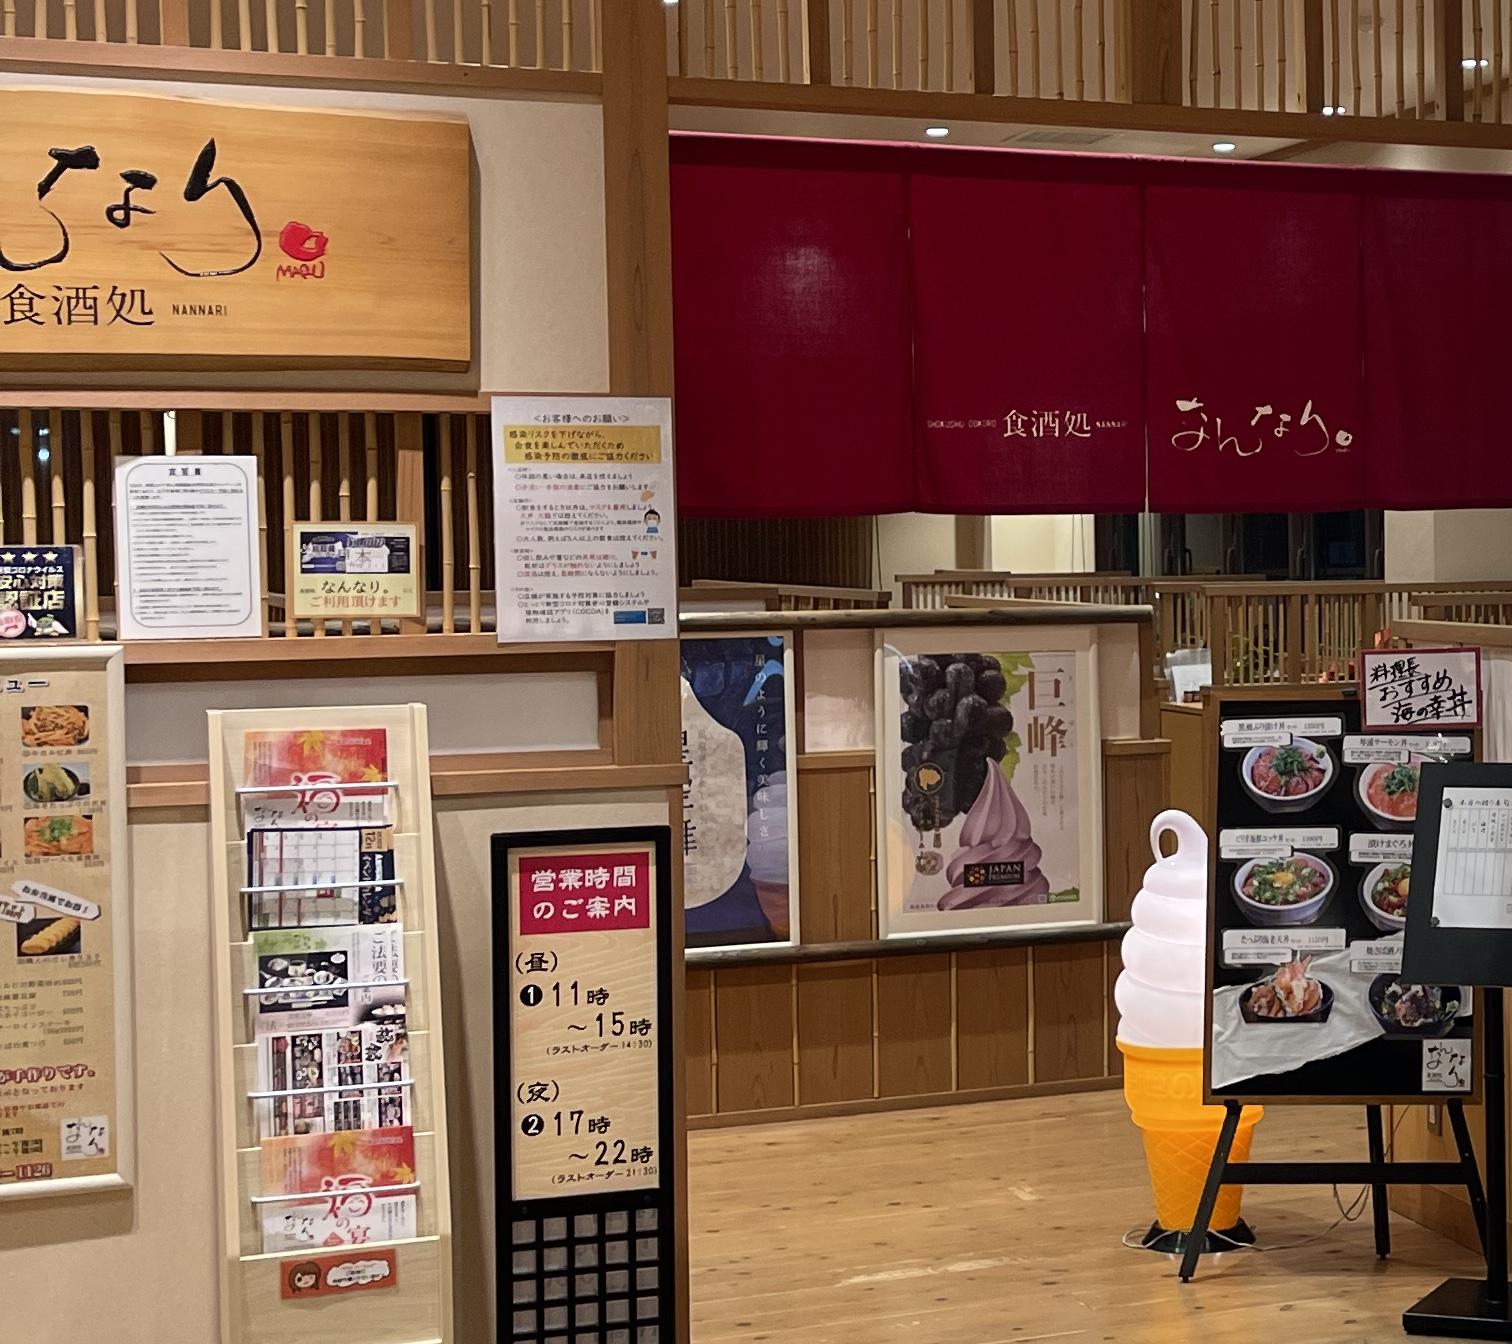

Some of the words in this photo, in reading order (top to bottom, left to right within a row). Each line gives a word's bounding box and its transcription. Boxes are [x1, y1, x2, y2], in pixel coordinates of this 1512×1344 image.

[275, 260, 327, 282] MARU
[1, 283, 156, 327] 食酒処
[172, 304, 229, 317] NANNARI
[1002, 408, 1092, 439] 食酒処
[0, 565, 65, 575] 型コロナウイルス
[310, 595, 401, 609] ご利用頂けます
[1379, 669, 1453, 701] おすすめ
[531, 864, 638, 894] 営業時間
[988, 863, 1022, 874] JAPAN
[533, 895, 637, 919] のご案内
